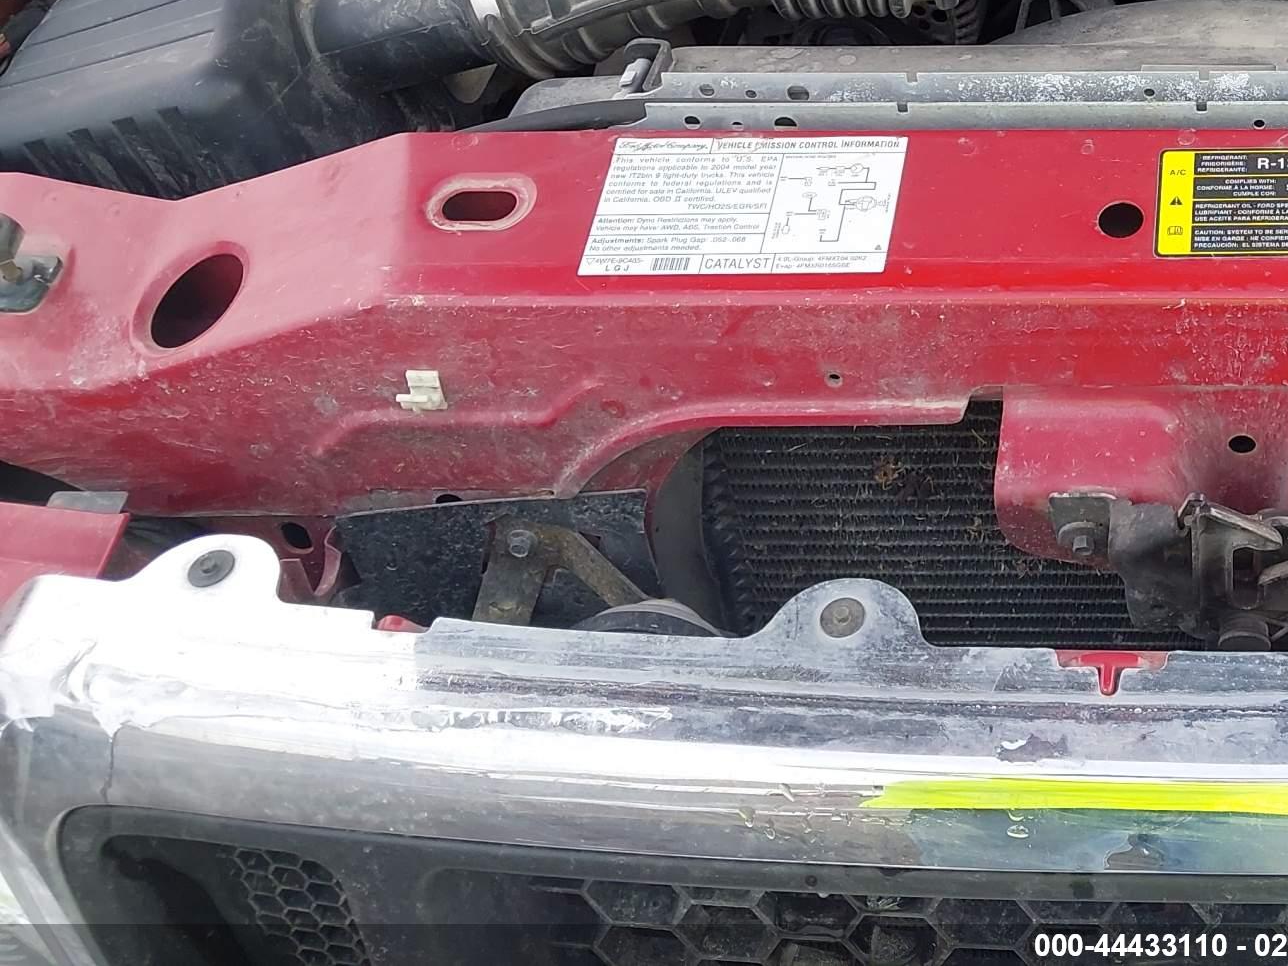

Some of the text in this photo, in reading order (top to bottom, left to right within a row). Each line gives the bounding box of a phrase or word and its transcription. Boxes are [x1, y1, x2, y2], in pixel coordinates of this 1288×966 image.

[755, 141, 796, 149] EMISSION
[799, 141, 838, 149] CONTROL
[841, 140, 900, 148] INFORMATION
[592, 237, 644, 245] Adjustments:
[705, 258, 770, 269] CATALYST
